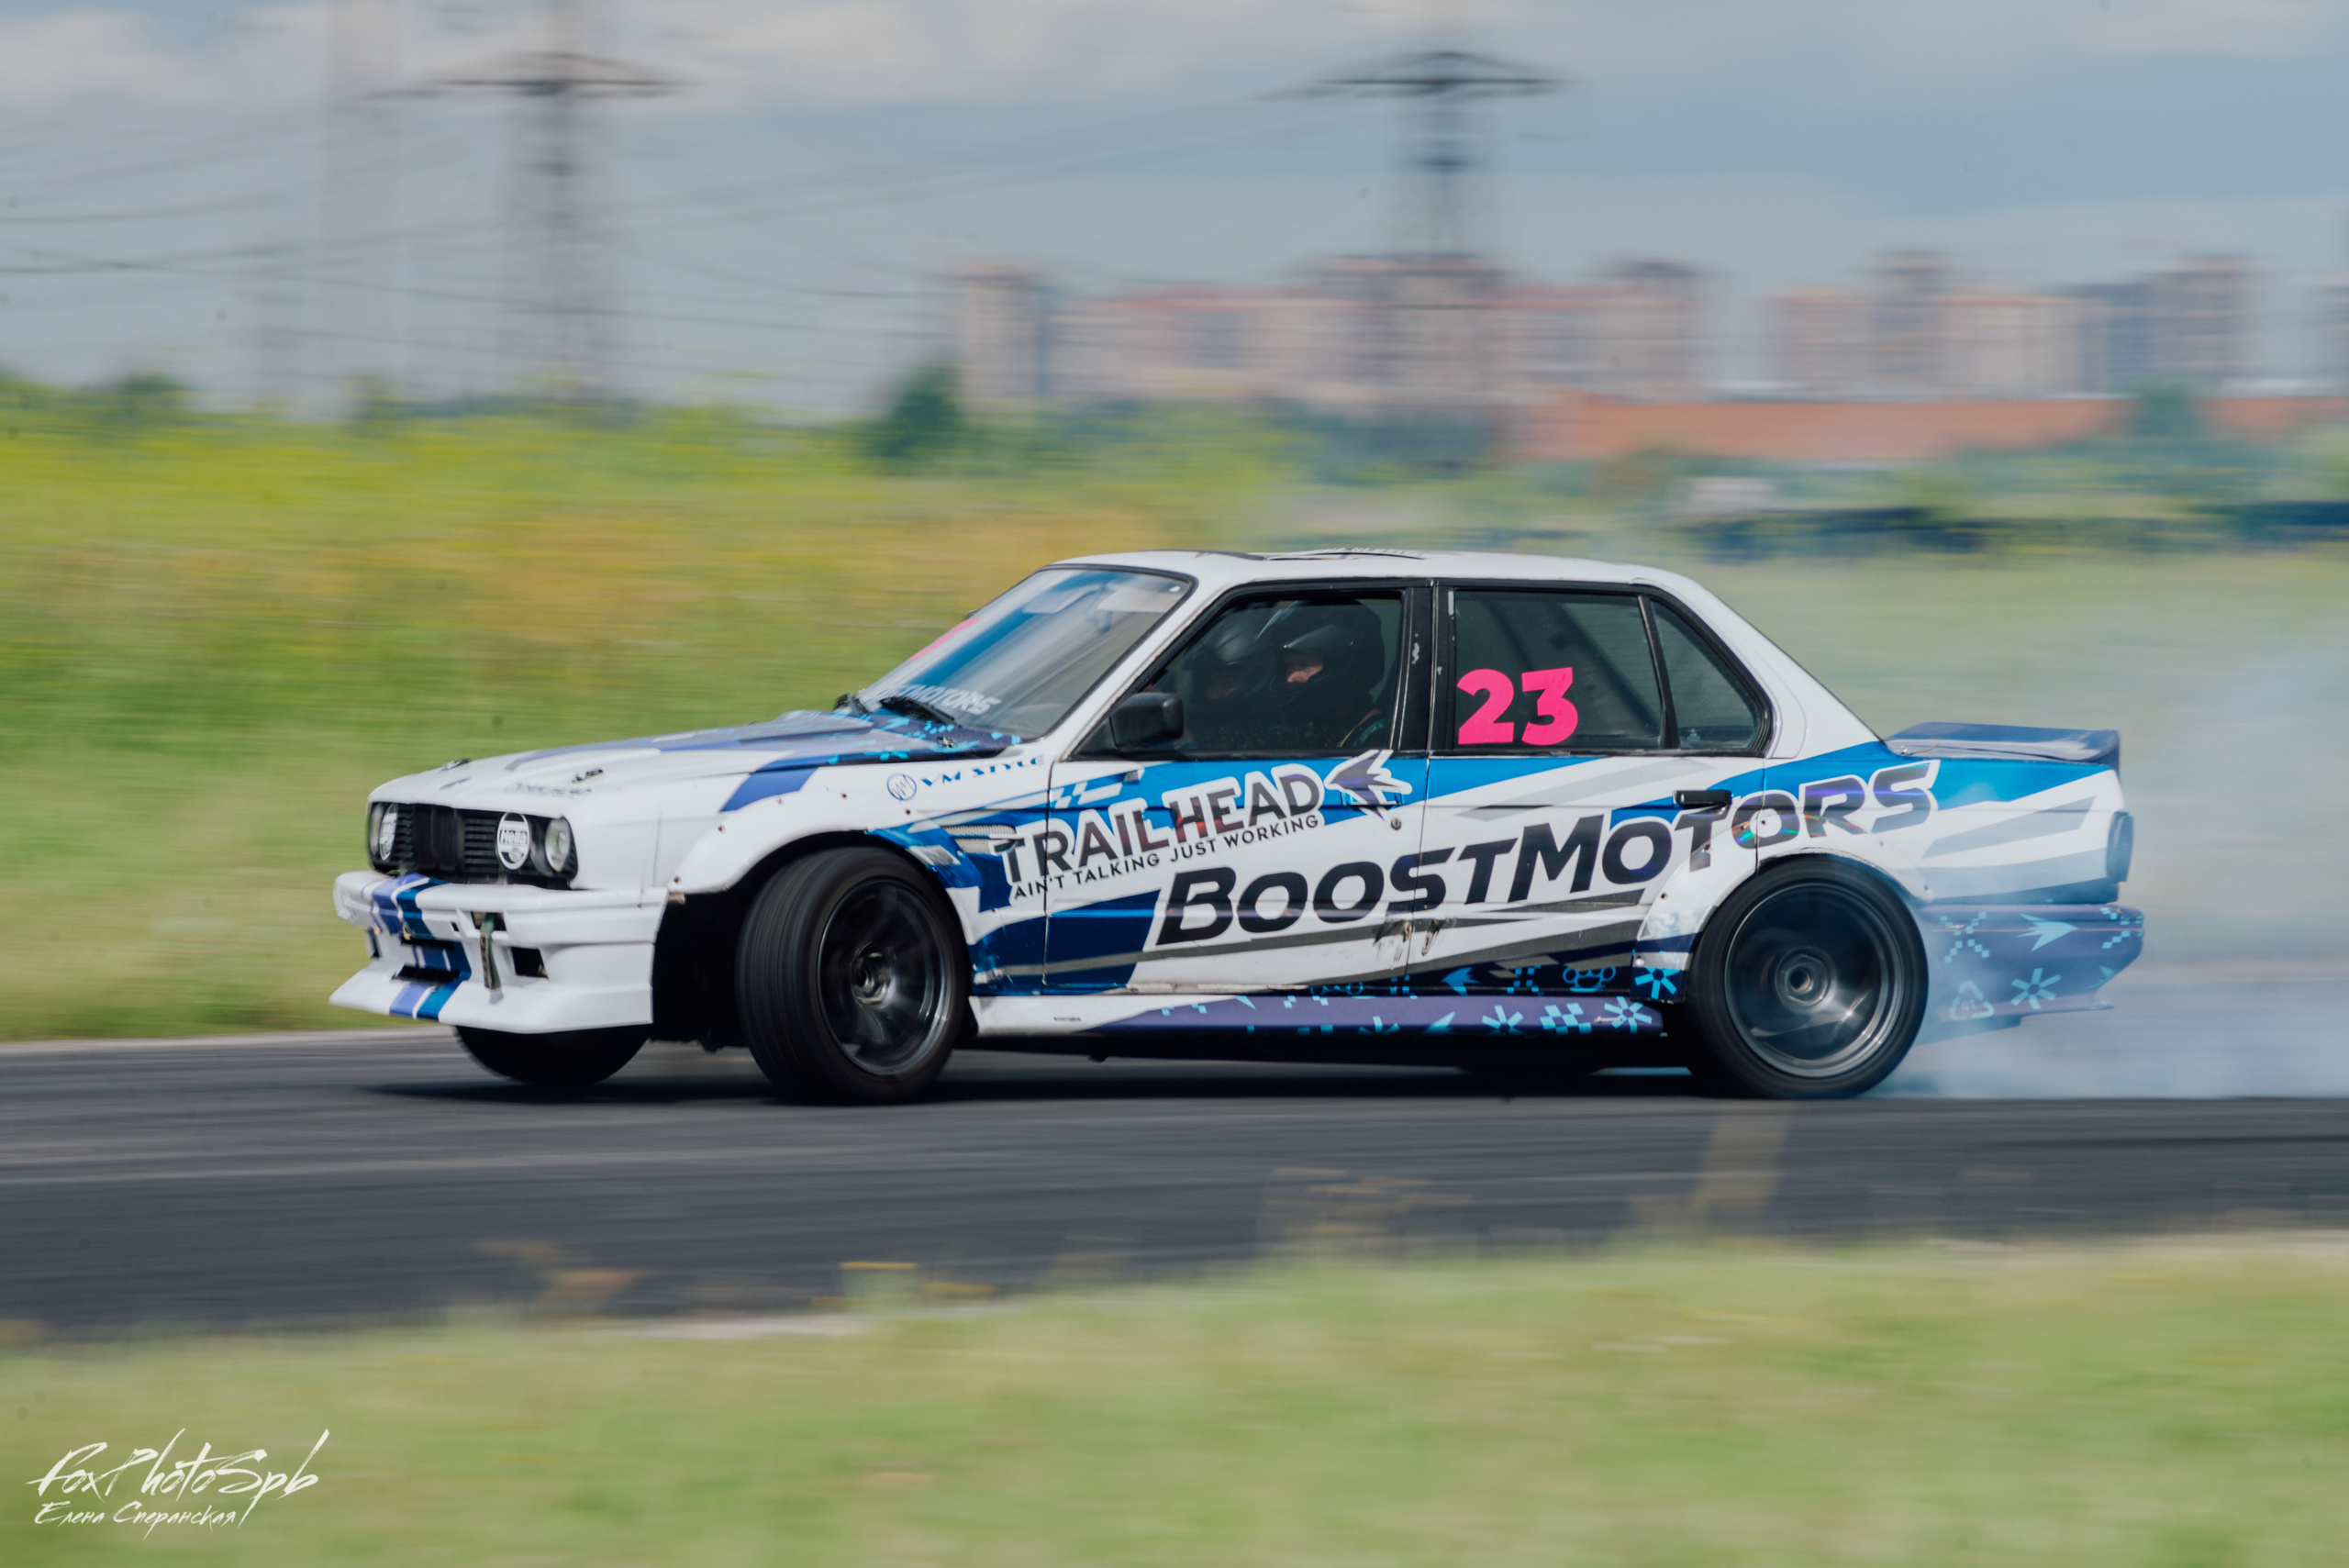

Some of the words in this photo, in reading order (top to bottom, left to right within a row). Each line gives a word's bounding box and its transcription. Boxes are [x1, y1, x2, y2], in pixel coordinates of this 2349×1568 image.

[1456, 667, 1578, 746] 23
[921, 771, 961, 786] VM
[972, 755, 1044, 779] STYLE
[994, 773, 1321, 883] TRAILHEAD
[1014, 875, 1065, 900] AIN'T
[1072, 854, 1160, 886] TALKING
[1169, 840, 1218, 862] JUST
[1222, 814, 1319, 849] WORKING
